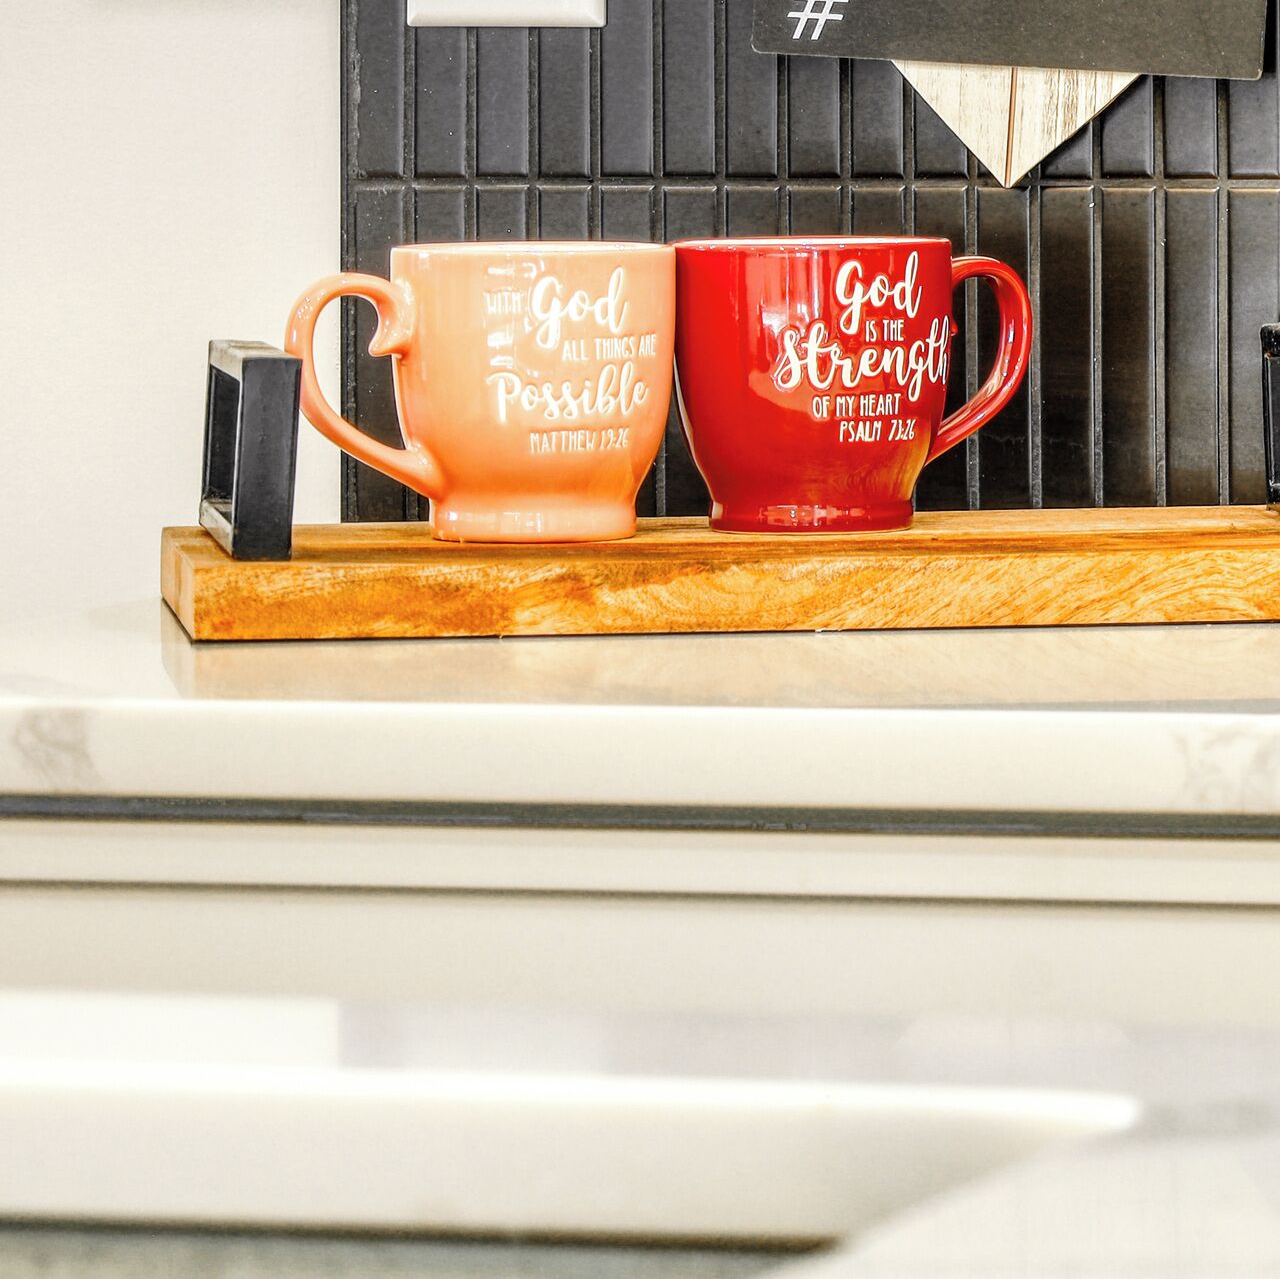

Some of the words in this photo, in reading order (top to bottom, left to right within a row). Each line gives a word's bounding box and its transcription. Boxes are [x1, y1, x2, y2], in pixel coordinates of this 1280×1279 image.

[836, 250, 923, 335] God
[485, 291, 523, 315] WITH
[531, 266, 628, 350] God
[865, 319, 878, 343] IS
[883, 318, 905, 342] THE
[562, 339, 589, 362] ALL
[594, 336, 636, 361] THINGS
[638, 333, 657, 357] ARE
[774, 315, 949, 402] Strength
[486, 361, 650, 423] Possible
[812, 395, 830, 418] OF
[835, 394, 856, 417] MY
[859, 392, 902, 417] HEART
[529, 429, 596, 454] MATTHEW
[599, 427, 631, 451] 19:26
[839, 419, 882, 443] PSALM
[887, 418, 917, 442] 73:26
